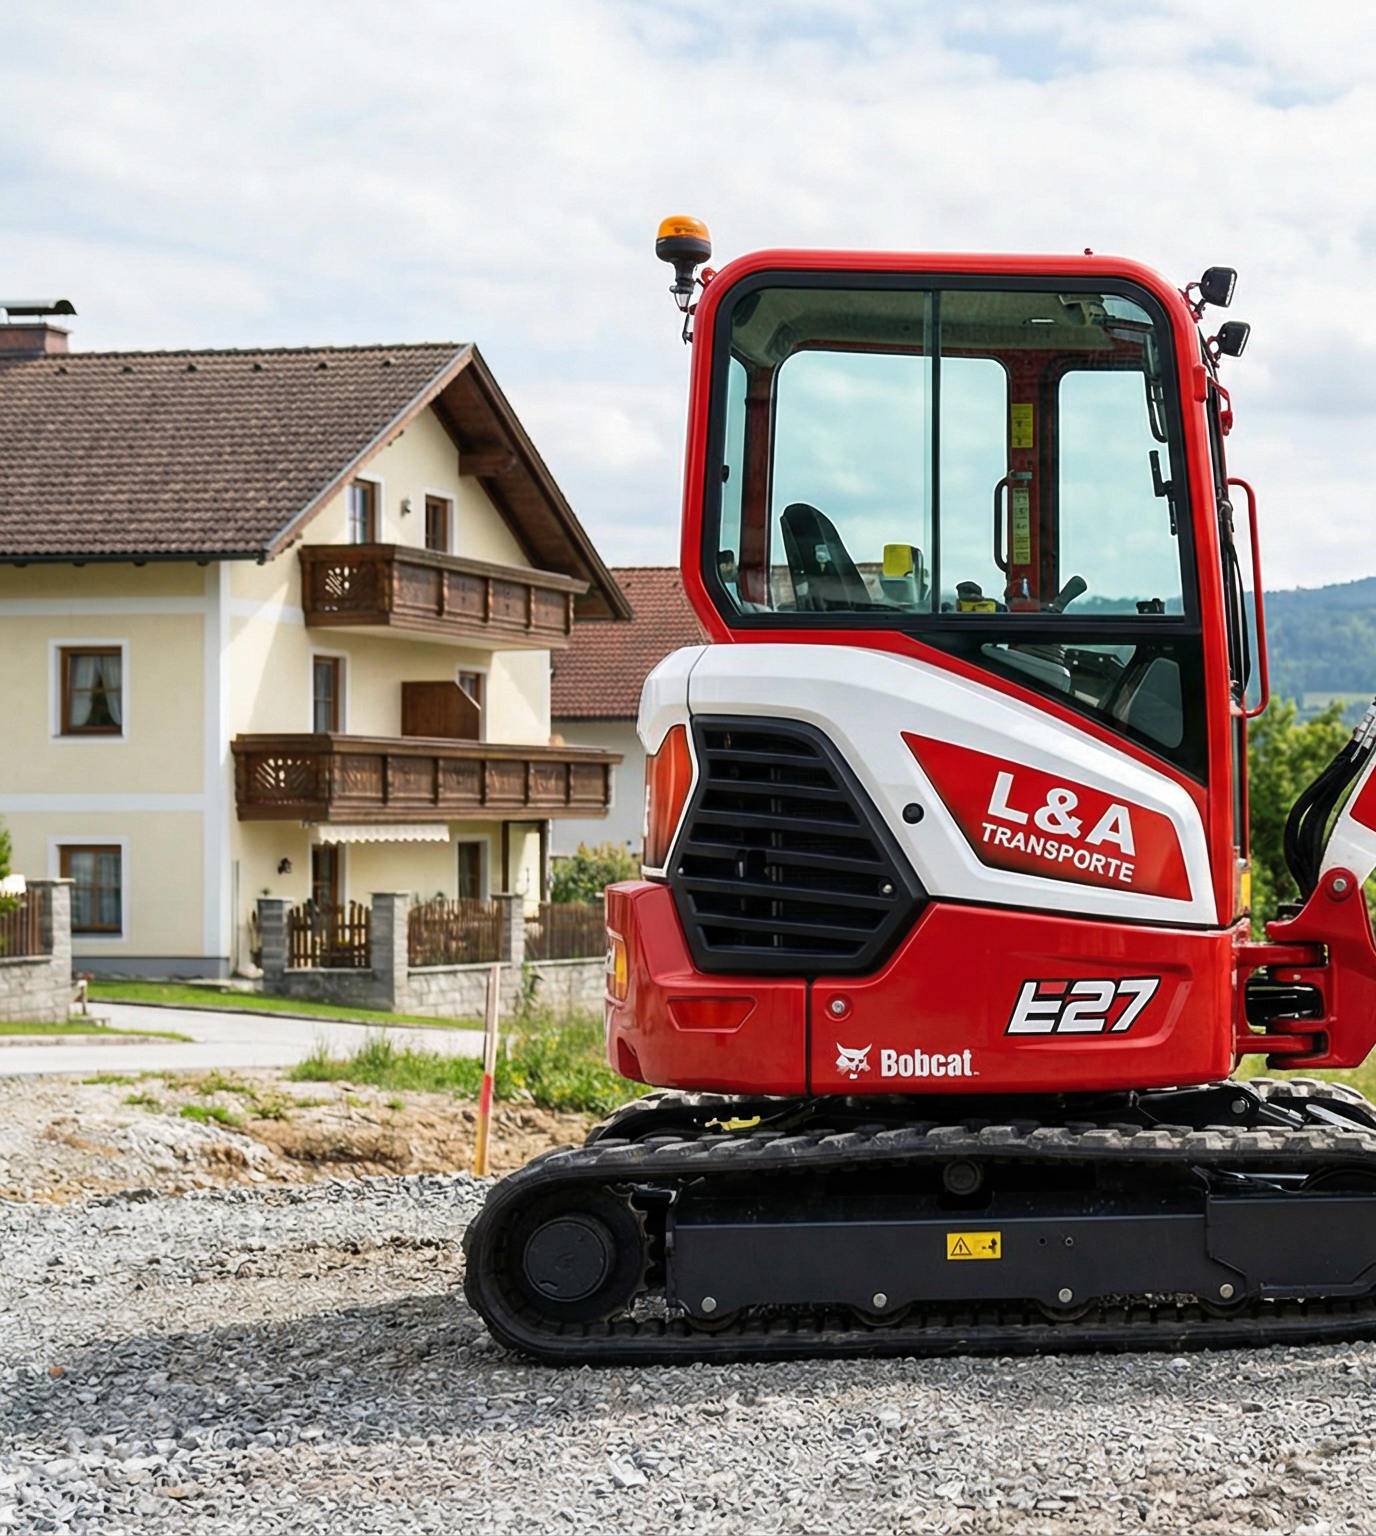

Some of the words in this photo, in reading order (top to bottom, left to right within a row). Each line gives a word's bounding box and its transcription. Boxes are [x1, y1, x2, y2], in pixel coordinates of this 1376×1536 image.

[987, 770, 1136, 857] L&A
[981, 822, 1135, 883] TRANSPORTE
[1005, 978, 1162, 1036] E27
[880, 1048, 973, 1077] Bobcat
